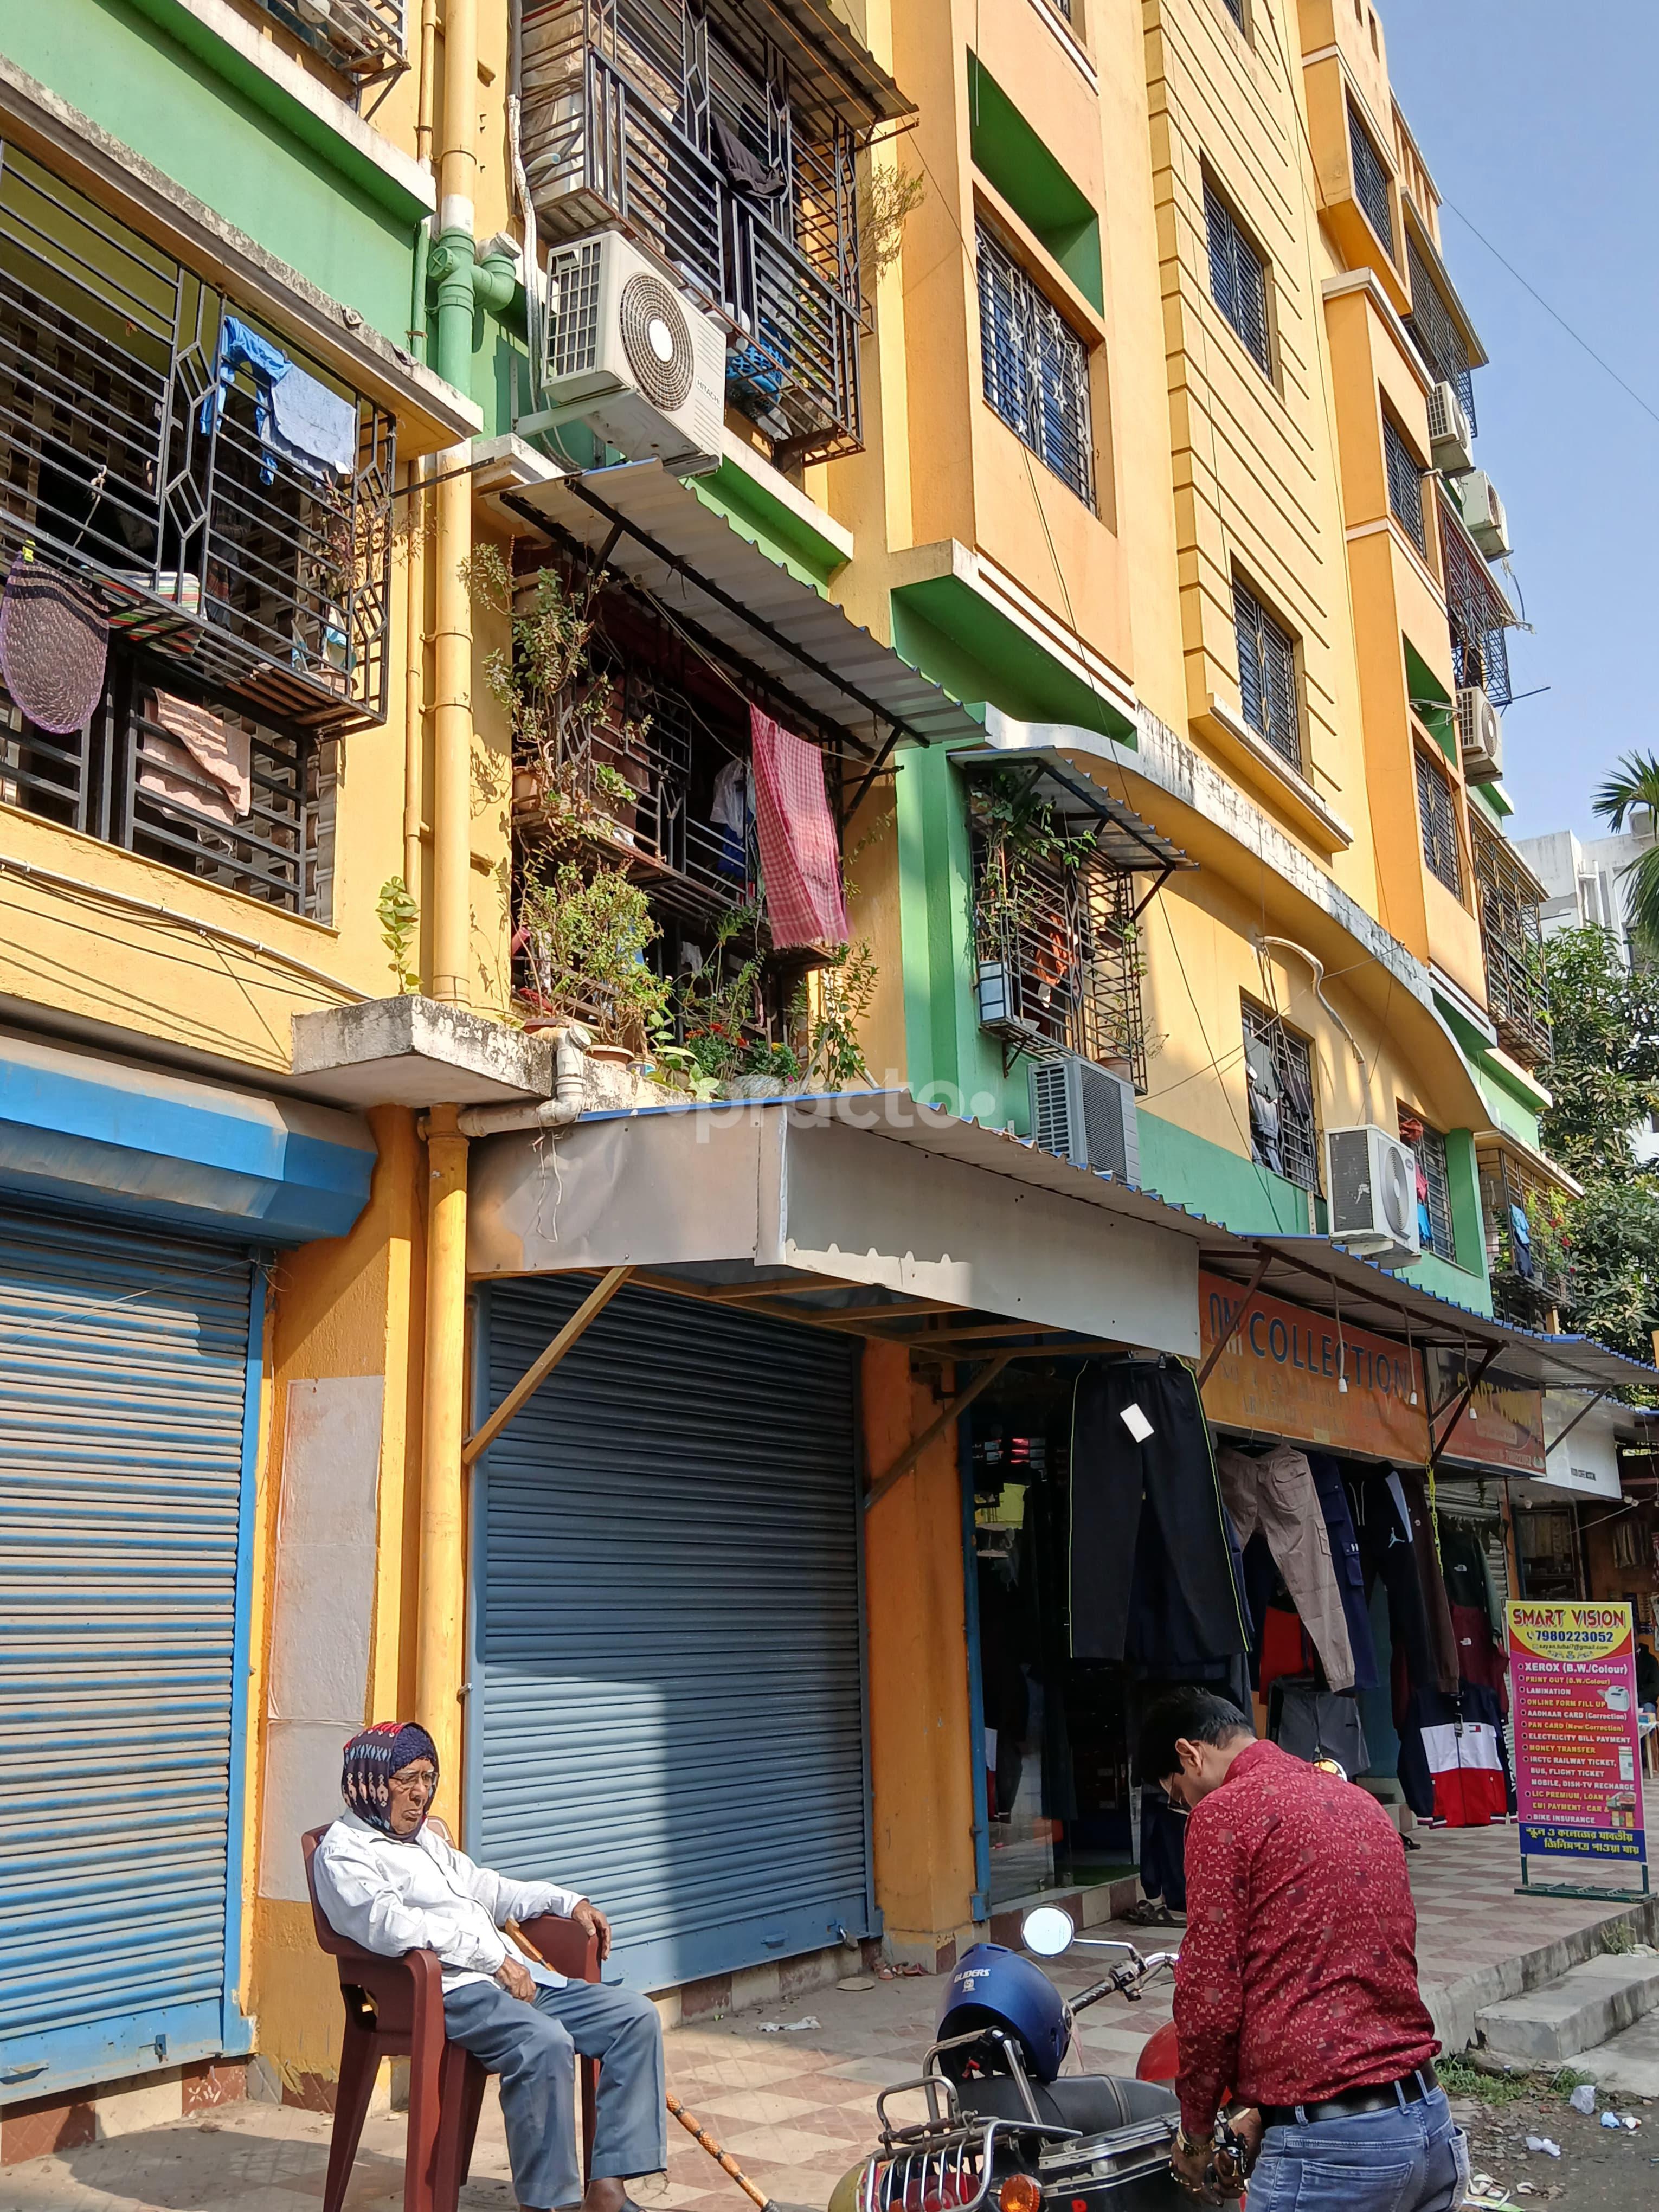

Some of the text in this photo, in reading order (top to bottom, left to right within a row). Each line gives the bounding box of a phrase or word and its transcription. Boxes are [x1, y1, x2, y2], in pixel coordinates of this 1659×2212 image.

[697, 379, 720, 406] HITACHI
[1249, 1310, 1409, 1398] COLLECTION
[1513, 1609, 1625, 1628] SMART VISION
[1535, 1630, 1613, 1642] 7980223052
[1525, 1662, 1628, 1675] XEROX (B.W./Colour)
[1526, 1687, 1571, 1695] LAMINATION
[1528, 1710, 1561, 1718] AADHAAR
[1585, 1712, 1627, 1721] (Correction)
[1528, 1733, 1576, 1741] ELECTRICITY
[1557, 1745, 1596, 1753] TRANSFER
[1554, 1757, 1586, 1765] RAILWAY
[1587, 1758, 1617, 1767] TICKET,
[1531, 1767, 1547, 1776] BUS,
[1532, 1779, 1561, 1787] MOBILE,
[1594, 1782, 1635, 1790] RECHARGE
[1546, 1791, 1582, 1800] PREMIUM,
[1553, 1815, 1596, 1823] INSURANCE
[1526, 1827, 1545, 1839] স্কুল
[1558, 1829, 1597, 1840] কলেজের
[1544, 1838, 1589, 1851] জিনিসপত্র
[954, 1969, 991, 1983] GLIDERS
